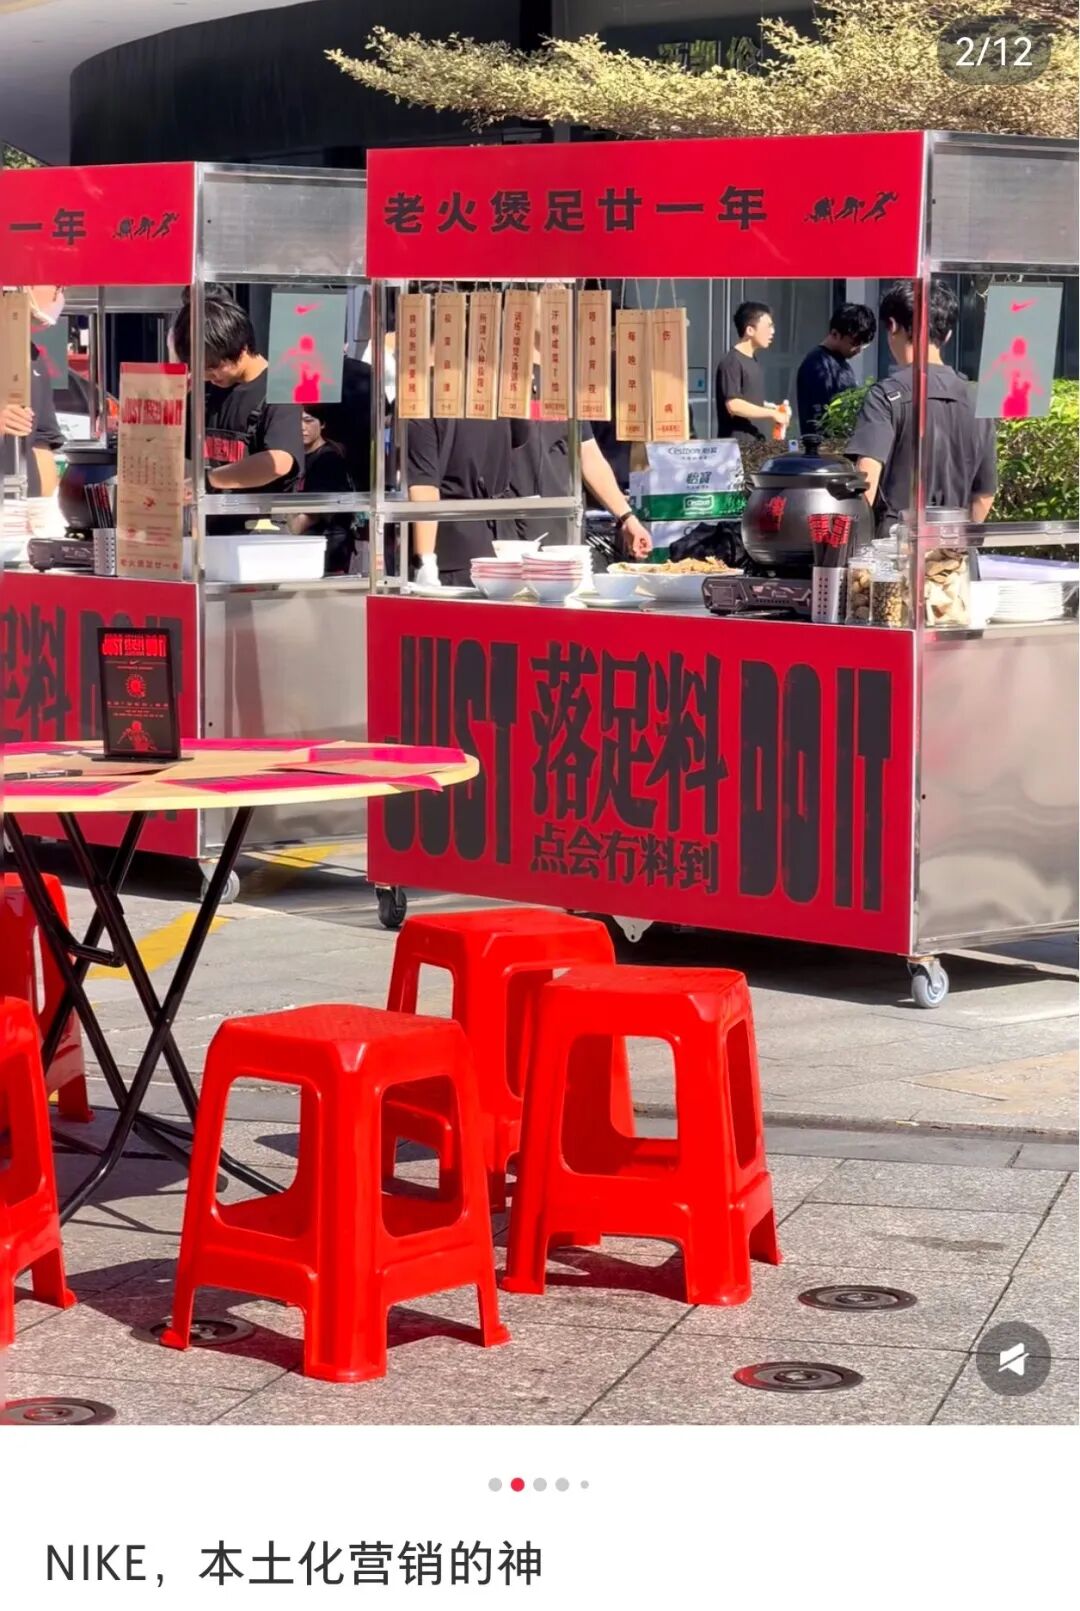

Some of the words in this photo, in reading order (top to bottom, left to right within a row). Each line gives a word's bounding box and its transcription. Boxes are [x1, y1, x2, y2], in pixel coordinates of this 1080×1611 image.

[10, 208, 87, 245] 一年
[383, 186, 768, 233] 老火煲足廿一年
[384, 635, 518, 864] JUST
[529, 640, 731, 835] 落足料
[738, 660, 822, 903] DO
[834, 667, 893, 912] IT
[529, 821, 720, 893] 点会冇料到
